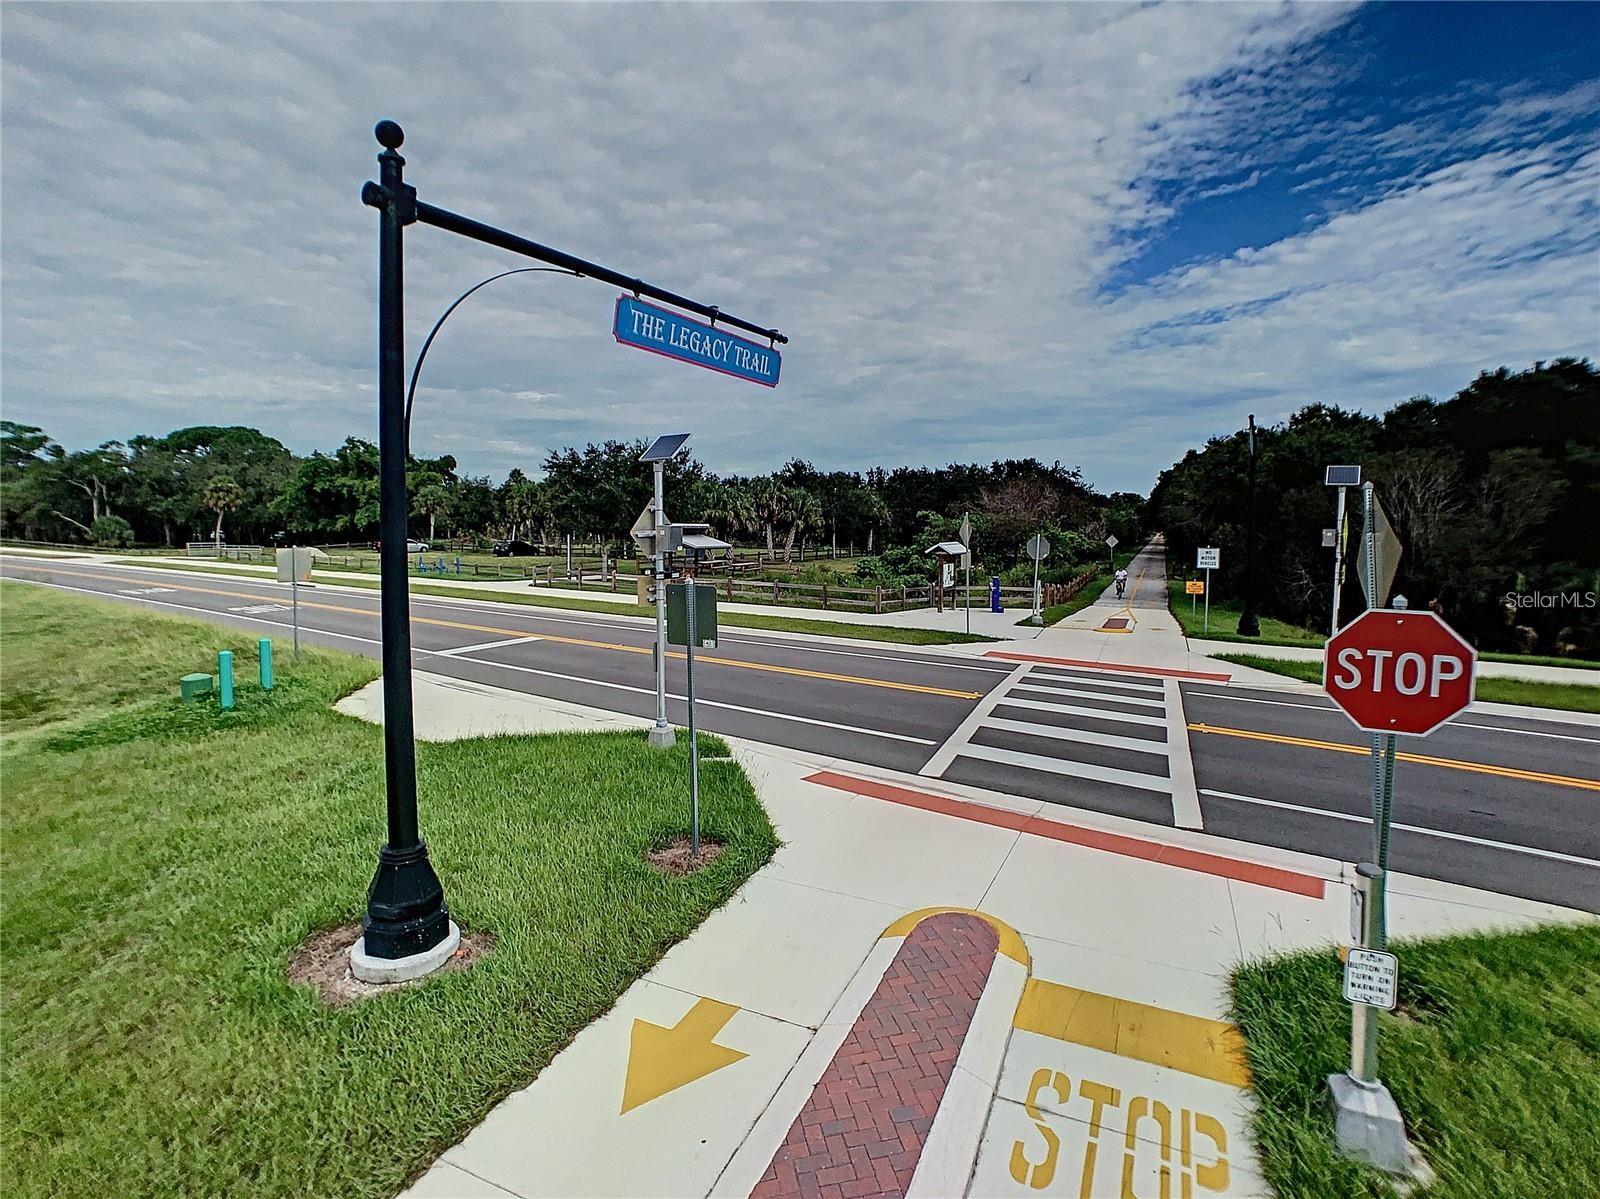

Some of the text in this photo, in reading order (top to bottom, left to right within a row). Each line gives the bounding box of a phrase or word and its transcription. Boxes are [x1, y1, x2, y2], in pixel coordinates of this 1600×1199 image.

[631, 309, 771, 376] THE LEGACY TRAIL
[1334, 648, 1464, 698] STOP
[1360, 953, 1384, 962] PUSH
[1350, 961, 1394, 976] BUTTON TO
[1351, 971, 1390, 985] TURN ON
[1350, 981, 1390, 995] WARNING
[1009, 1068, 1231, 1199] STOP
